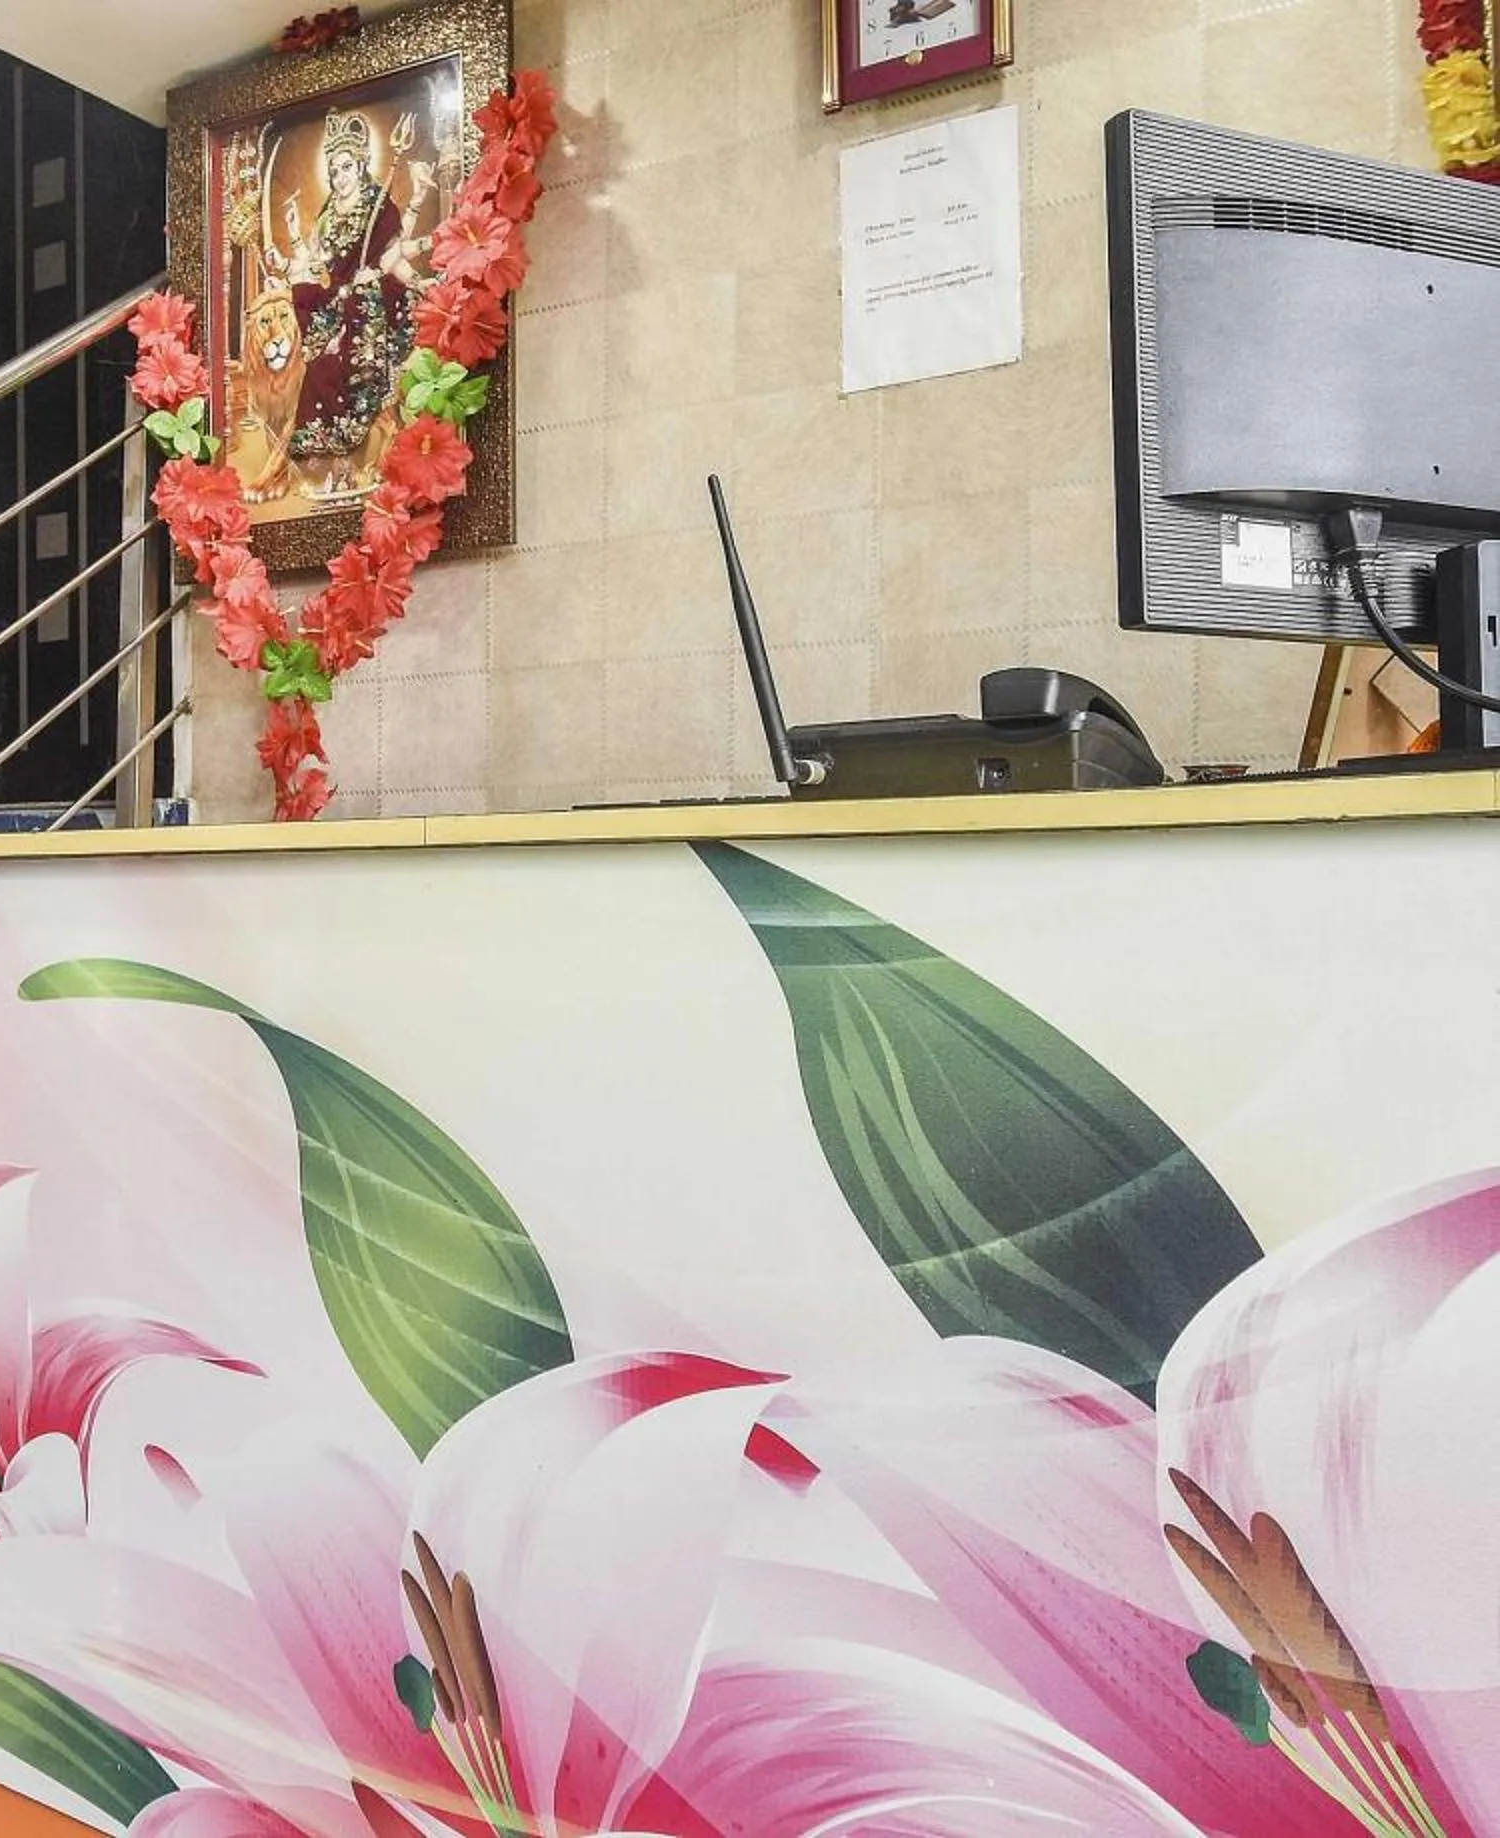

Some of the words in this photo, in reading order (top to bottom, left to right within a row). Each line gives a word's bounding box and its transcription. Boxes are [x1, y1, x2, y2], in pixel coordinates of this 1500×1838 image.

[867, 19, 877, 33] 8
[947, 21, 957, 37] 5
[915, 31, 925, 47] 6
[883, 39, 893, 56] 7
